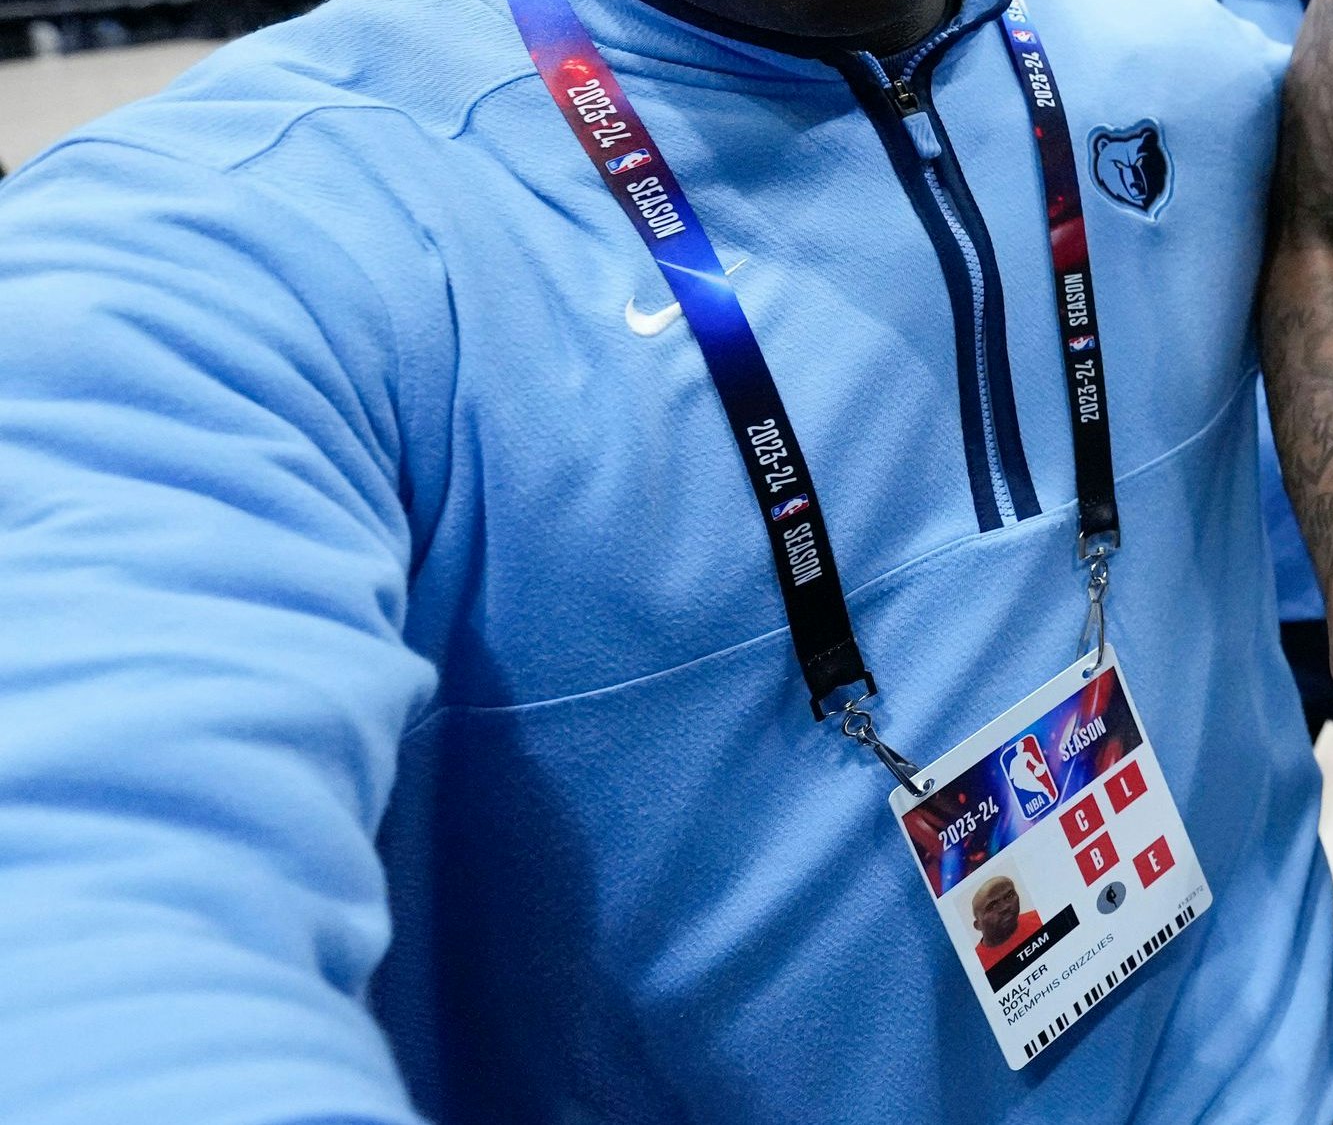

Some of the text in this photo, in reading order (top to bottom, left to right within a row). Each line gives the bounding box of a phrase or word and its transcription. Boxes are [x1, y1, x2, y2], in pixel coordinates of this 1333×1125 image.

[1022, 51, 1056, 108] 2023-24
[567, 80, 686, 242] 2023-24 SEASON
[1068, 272, 1100, 424] 2023-24 SEASON
[746, 418, 822, 587] 2023-24 SEASON
[938, 715, 1107, 852] 2023-24 NBA SEASON
[1121, 776, 1133, 799] L
[1074, 809, 1090, 832] C
[1090, 847, 1106, 872] B
[1148, 850, 1162, 874] E
[1016, 932, 1050, 962] TEAM
[998, 963, 1048, 1007] WALTER
[1007, 933, 1114, 1026] MEMPHIS GRIZZLIES
[1002, 988, 1031, 1016] DOTY
